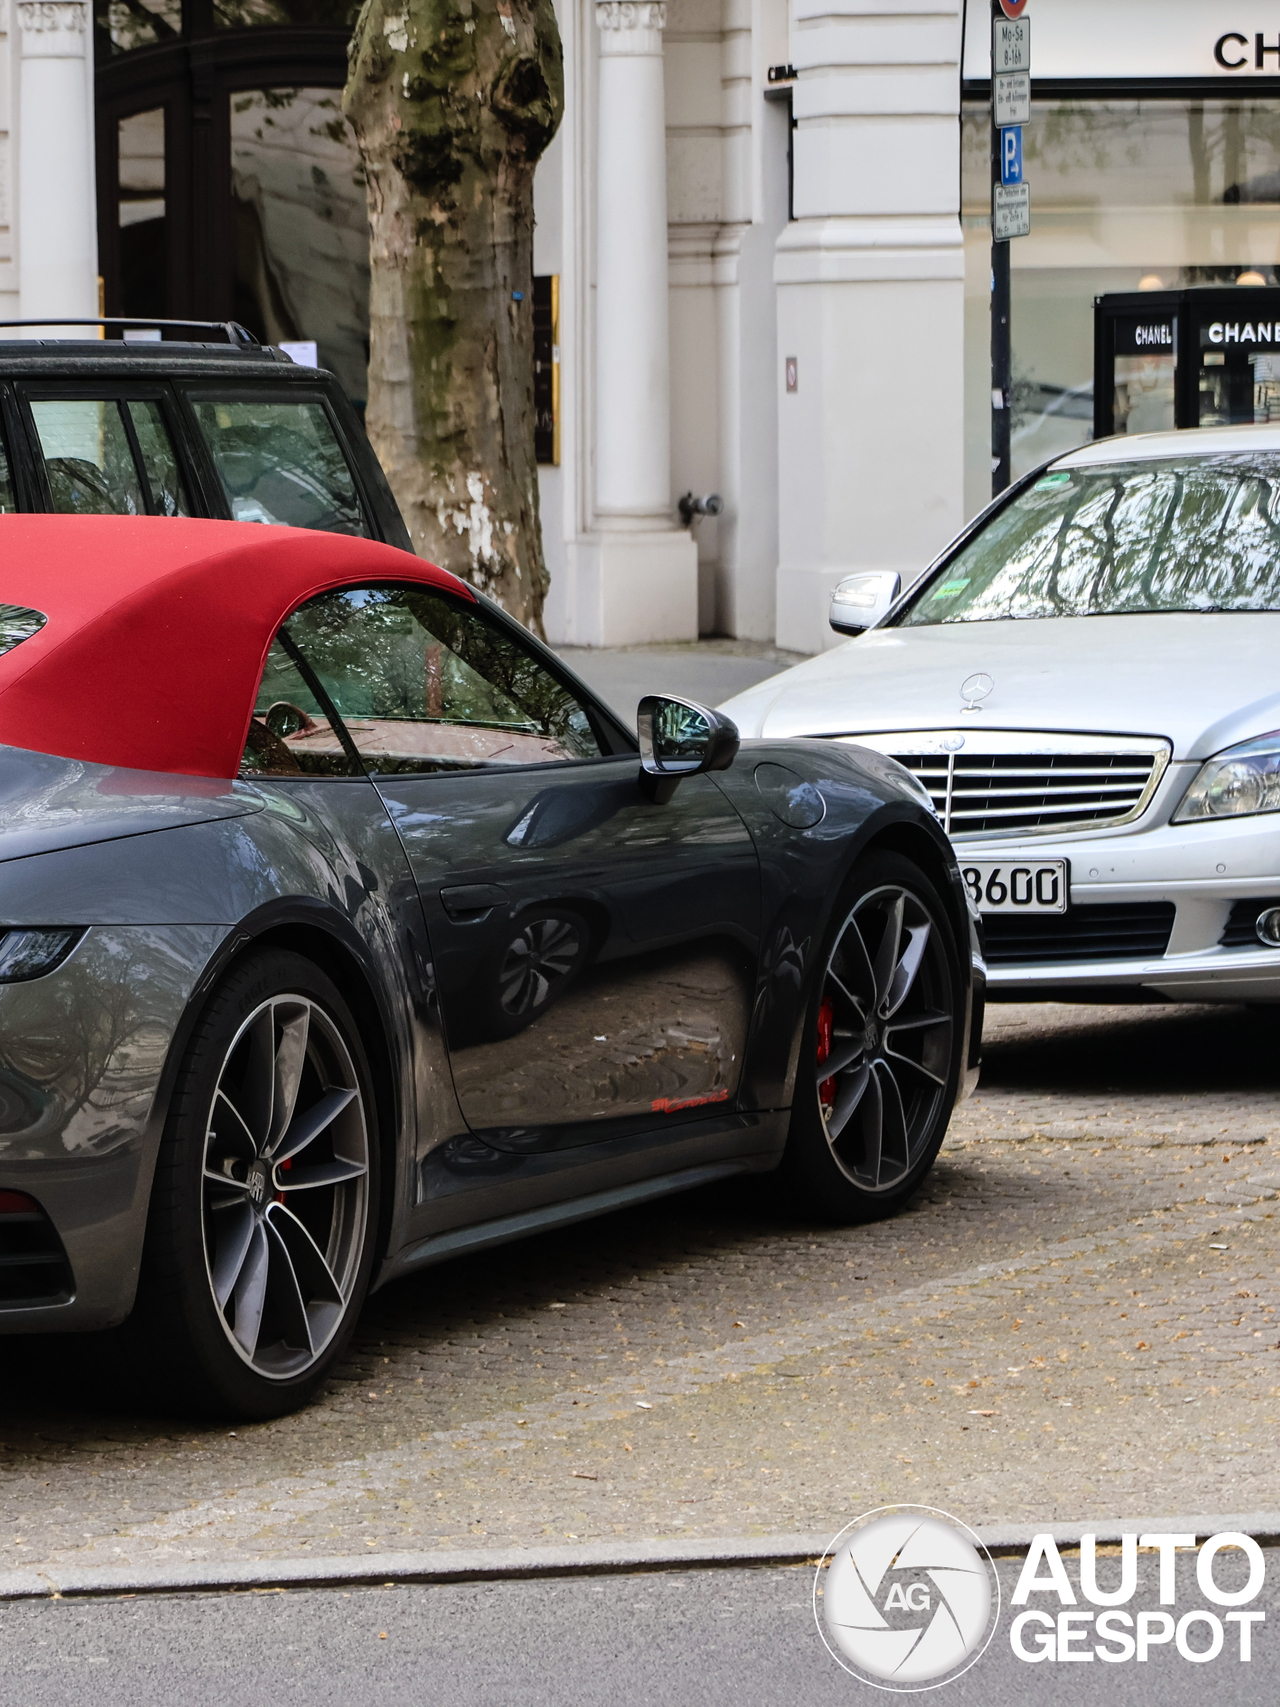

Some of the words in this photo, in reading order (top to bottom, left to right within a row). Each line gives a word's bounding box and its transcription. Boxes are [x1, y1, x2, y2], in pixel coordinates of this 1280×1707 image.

[1002, 25, 1024, 43] Mo-Sa
[1214, 32, 1280, 71] CH
[1005, 132, 1017, 178] P
[1135, 324, 1172, 345] CHANEL
[962, 867, 1059, 906] 8600
